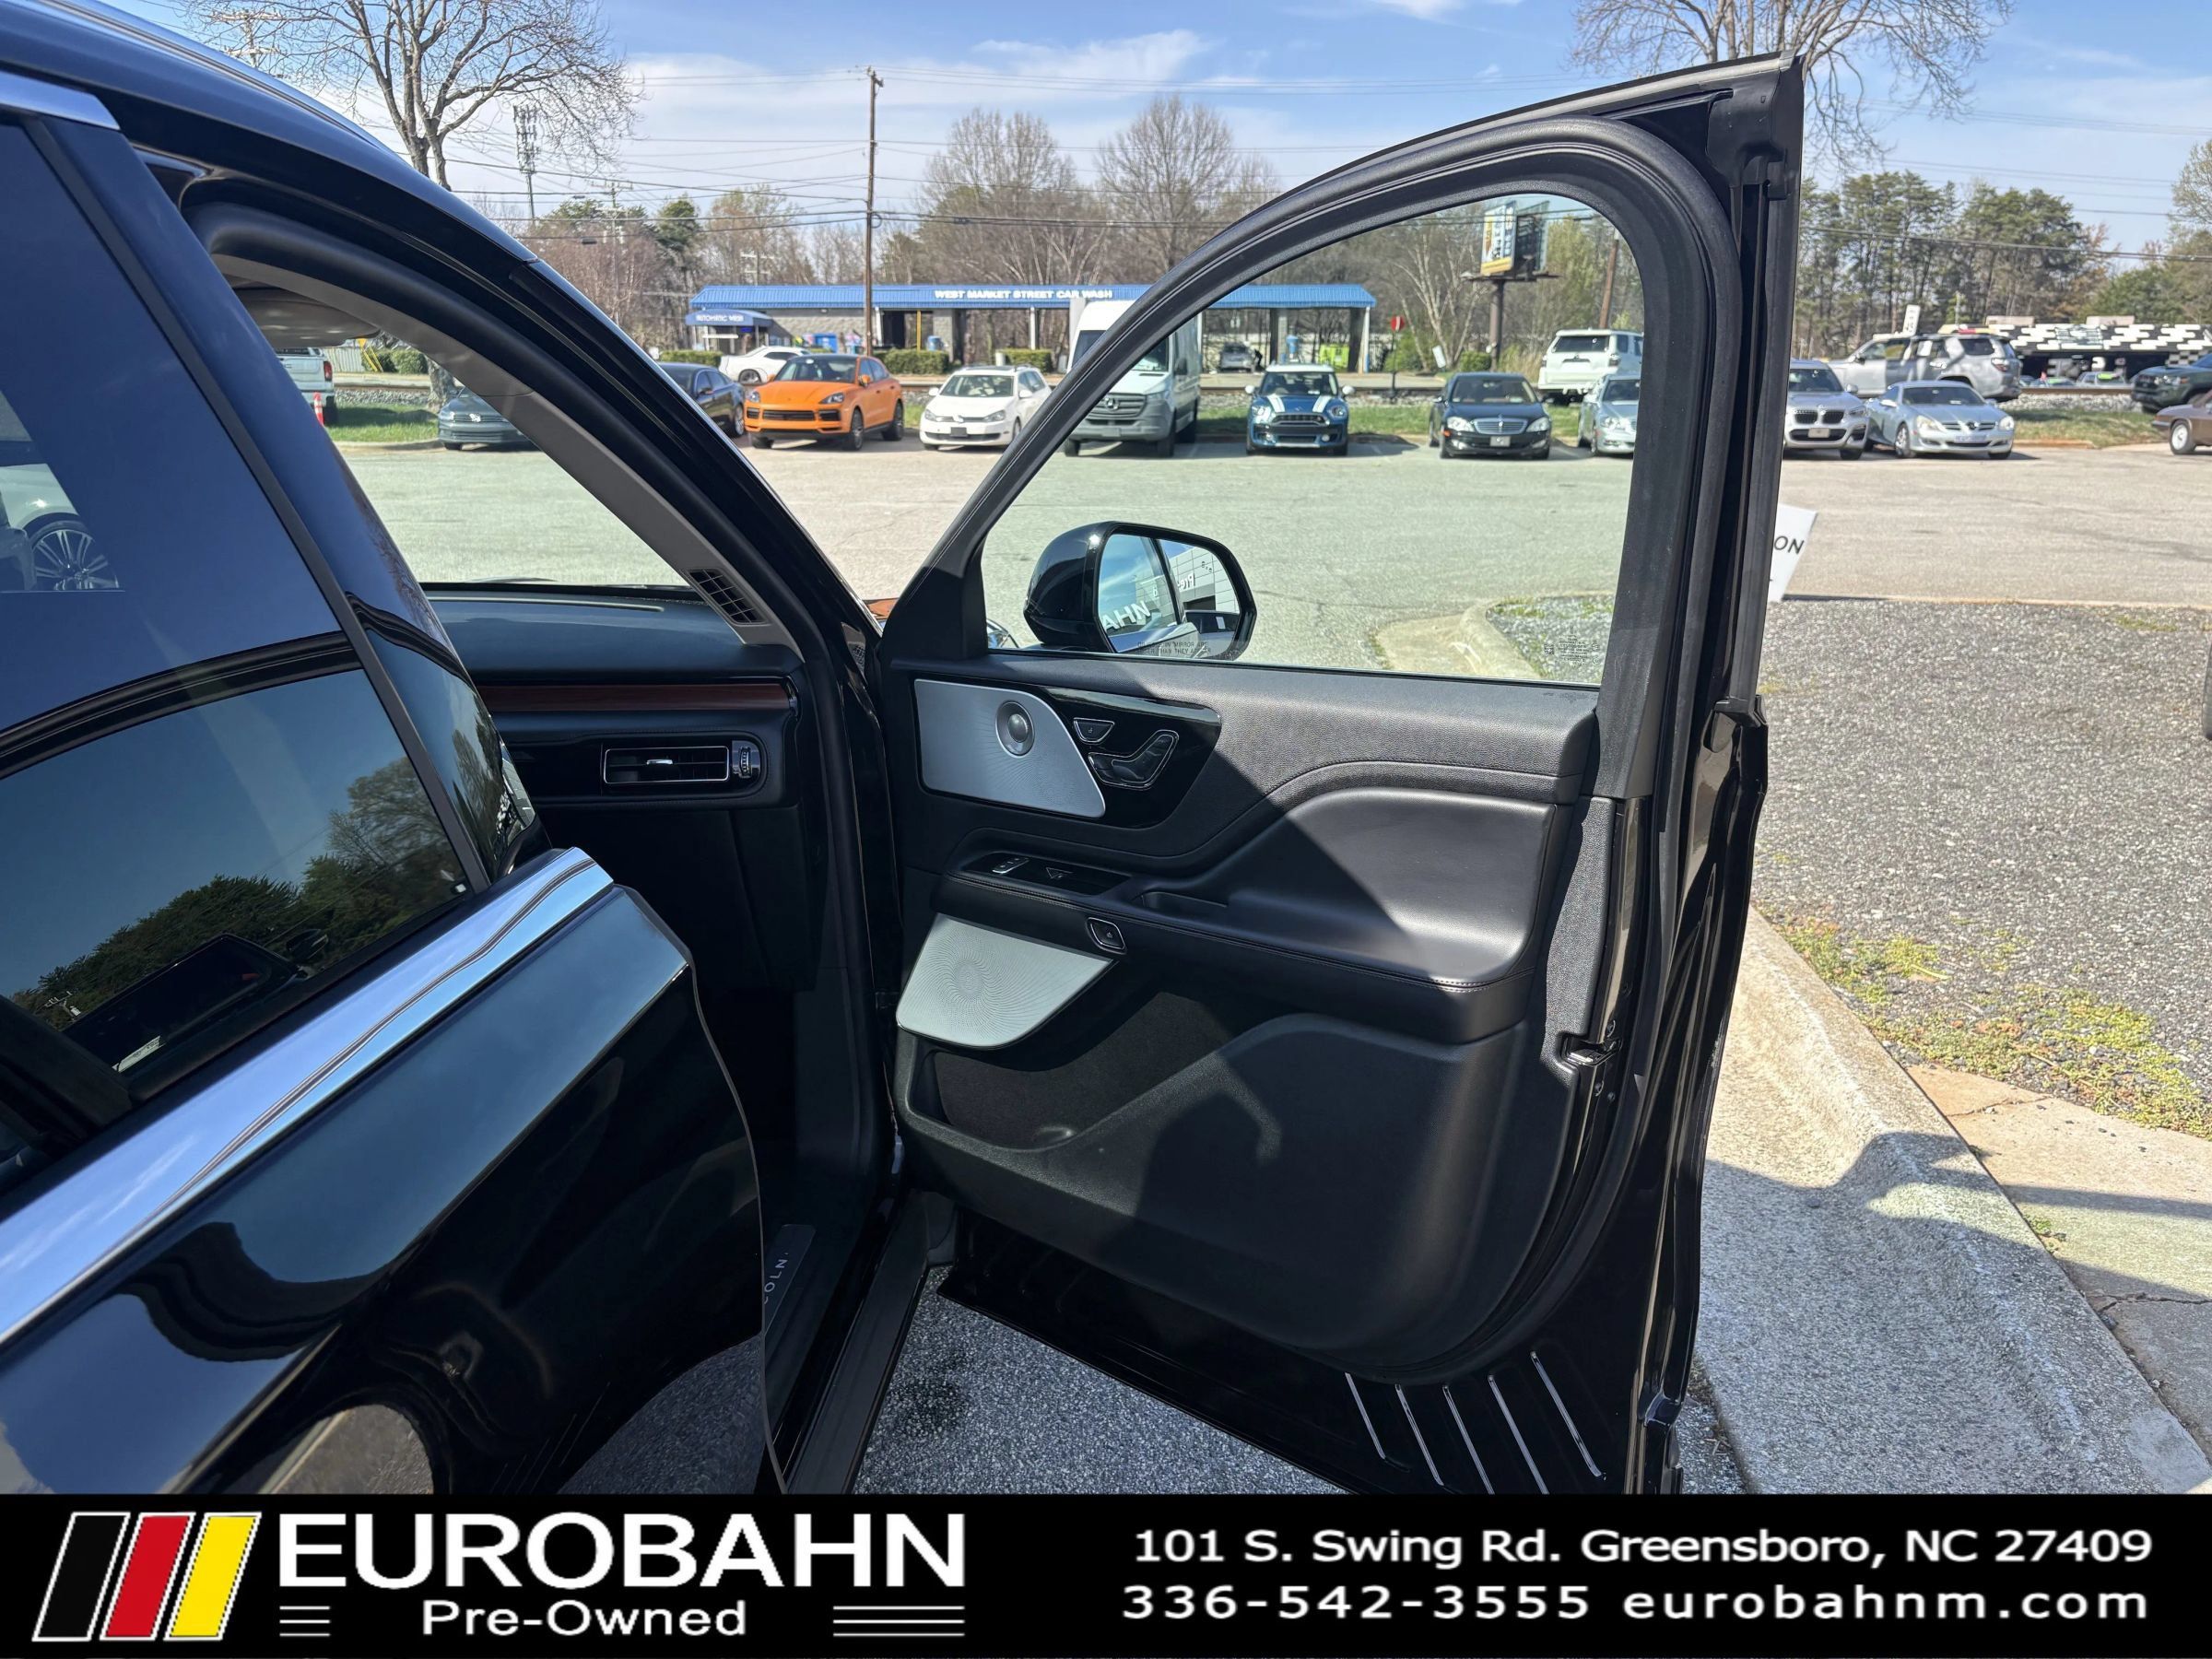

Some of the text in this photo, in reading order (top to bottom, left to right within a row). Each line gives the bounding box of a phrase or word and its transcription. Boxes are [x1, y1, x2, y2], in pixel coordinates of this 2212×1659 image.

[935, 290, 1112, 299] WEST MARKET STREET CAR WASH
